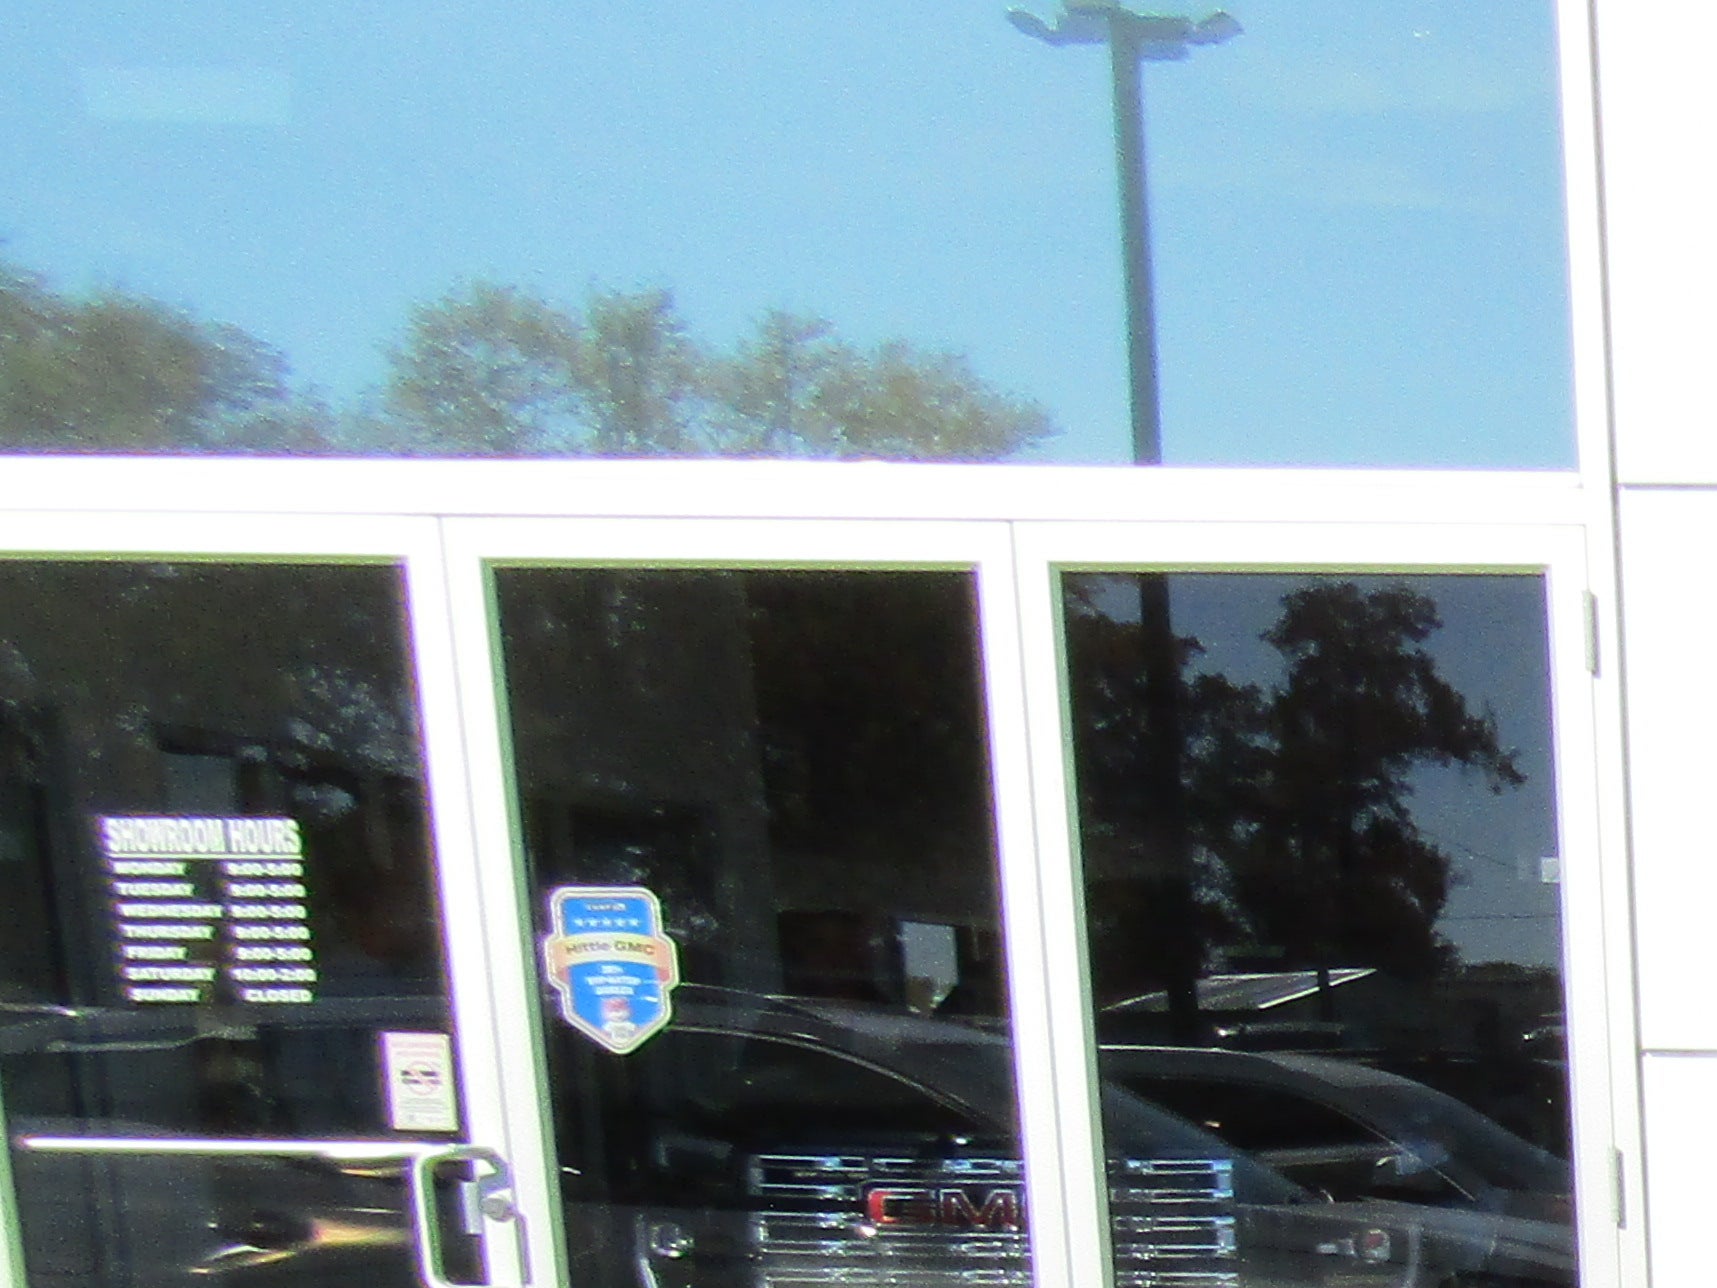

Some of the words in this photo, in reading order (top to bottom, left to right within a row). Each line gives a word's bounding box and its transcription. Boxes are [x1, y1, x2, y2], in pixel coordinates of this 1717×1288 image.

[106, 817, 227, 853] SHOWROOM
[229, 818, 302, 854] HOURS
[112, 861, 188, 876] MONDAY
[114, 882, 196, 897] TUESDAY
[117, 903, 224, 918] WEDNESDAY
[120, 924, 217, 940] THURSDAY
[123, 946, 189, 961] FRIDAY
[613, 940, 656, 956] GMC
[125, 967, 217, 982] SATURDAY
[129, 988, 201, 1003] SUNDAY
[243, 988, 314, 1004] CLOSED
[867, 1186, 1028, 1227] GM
